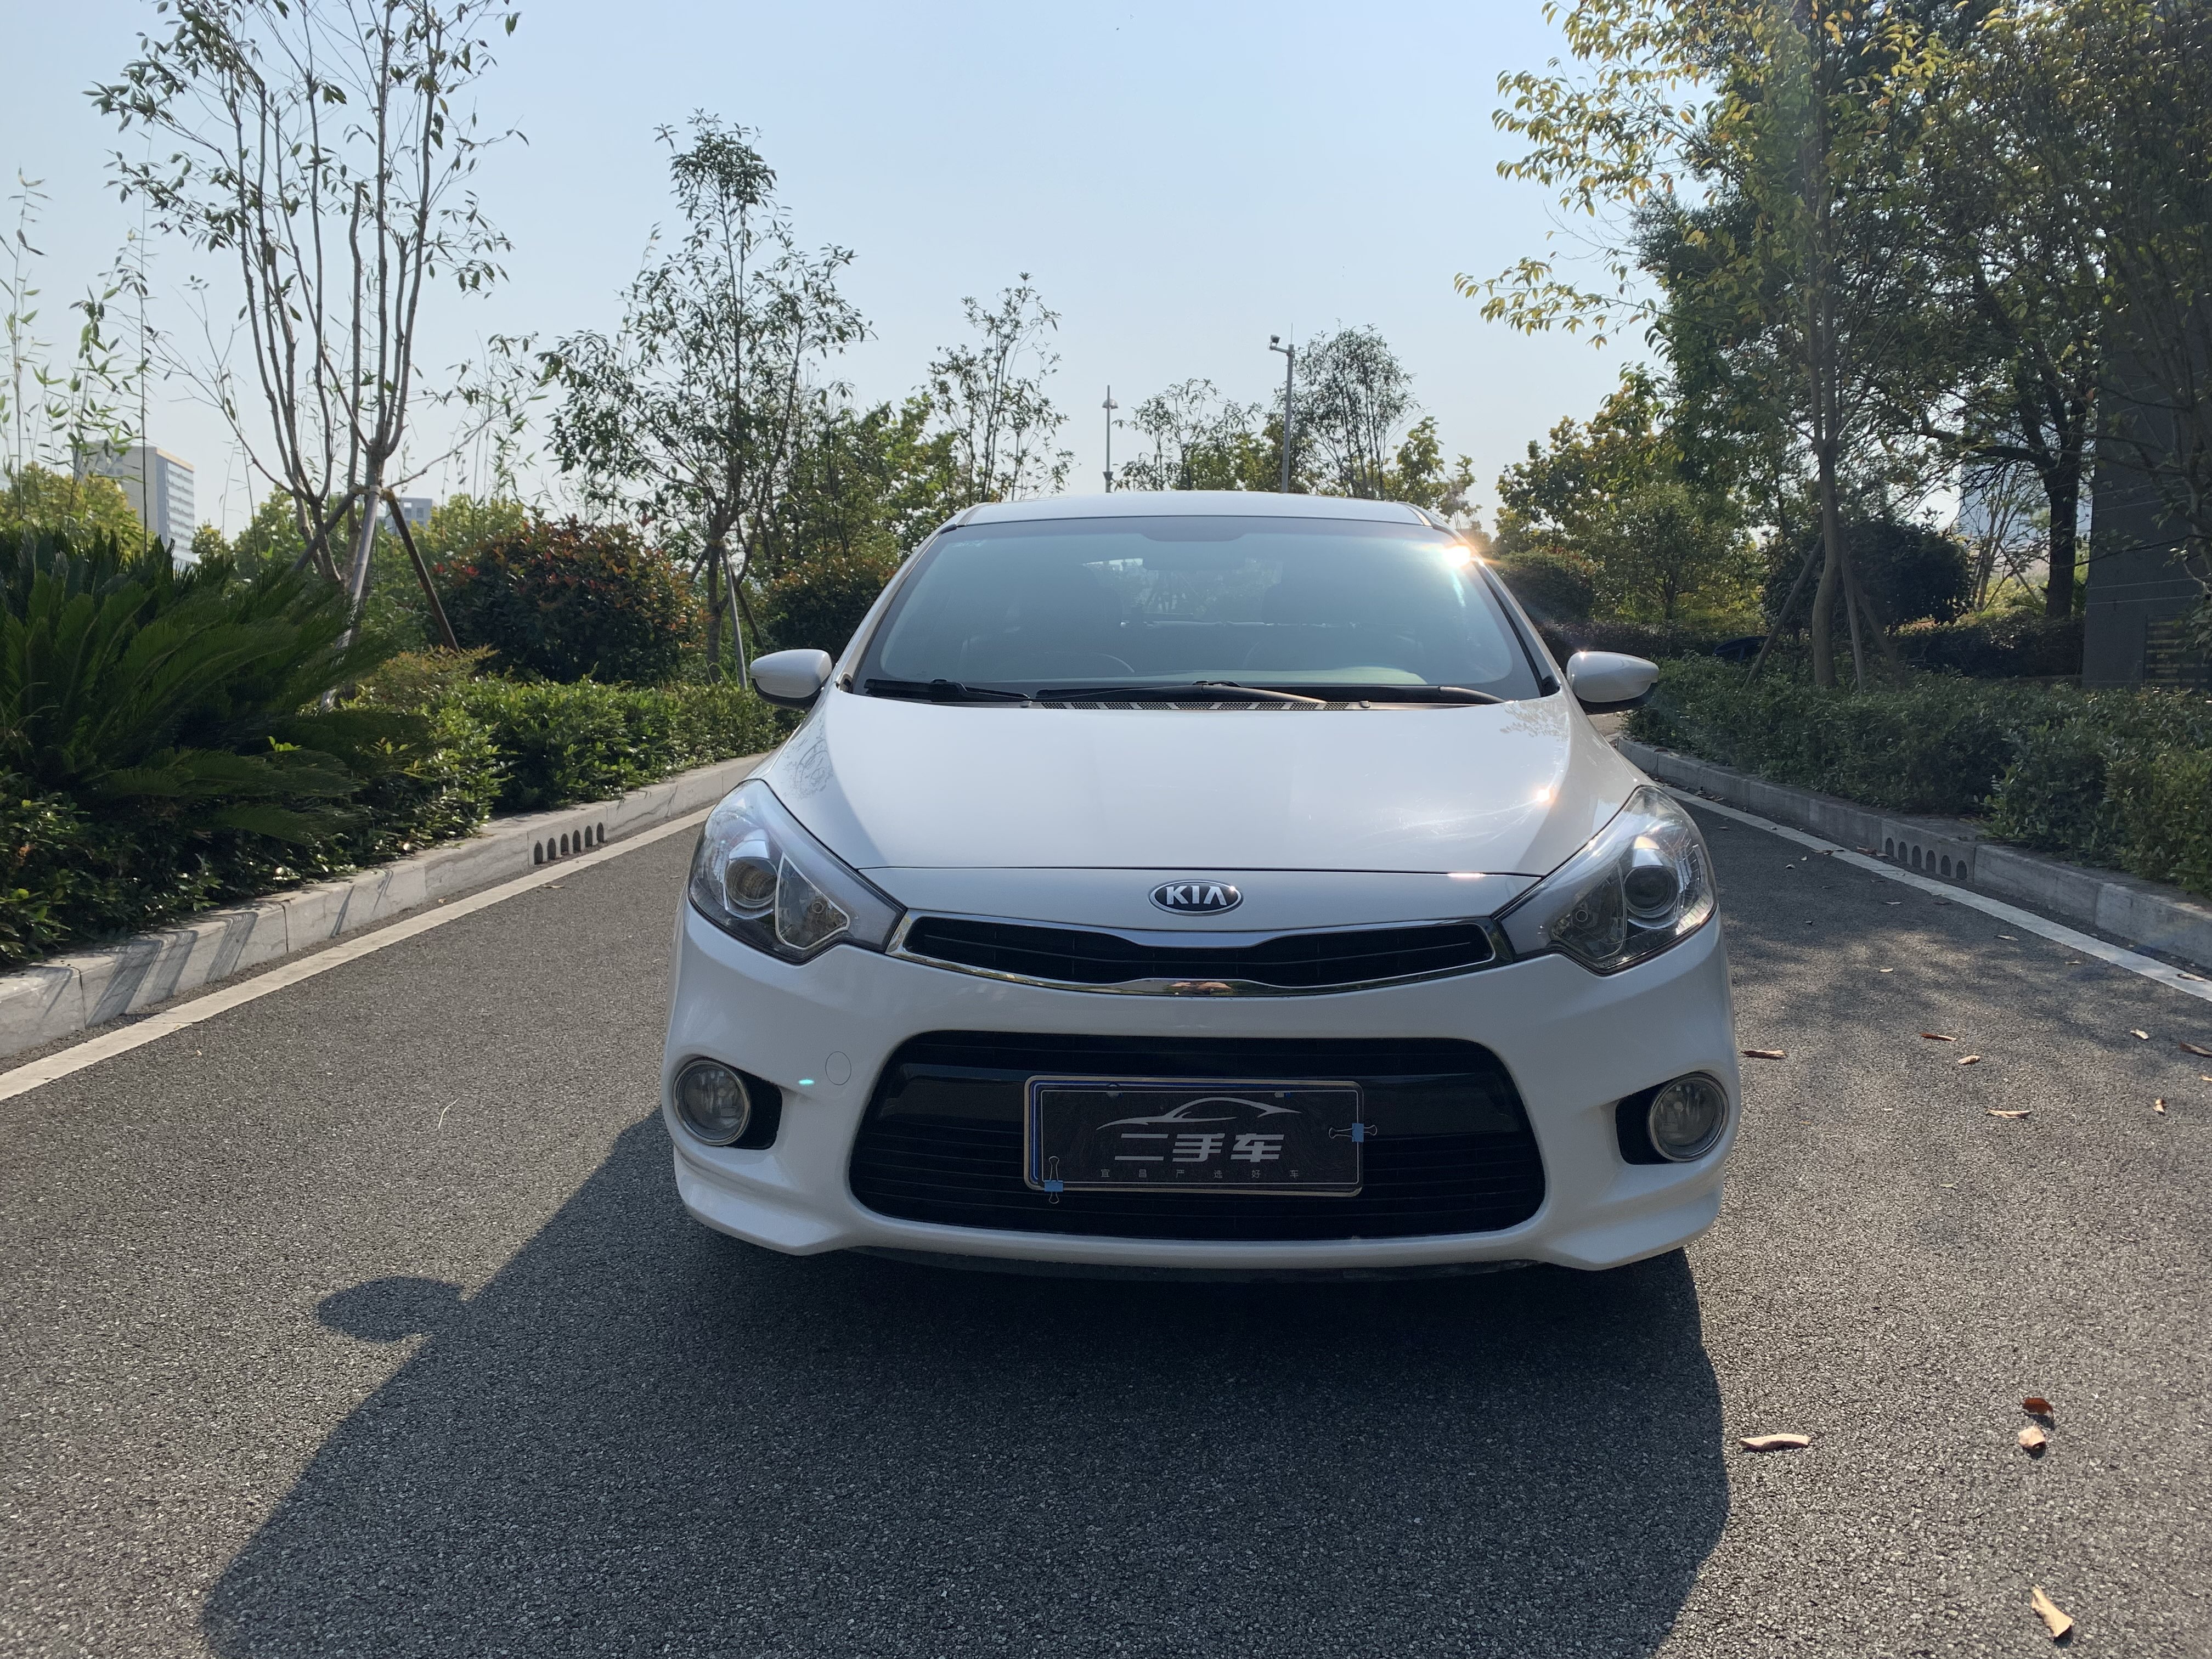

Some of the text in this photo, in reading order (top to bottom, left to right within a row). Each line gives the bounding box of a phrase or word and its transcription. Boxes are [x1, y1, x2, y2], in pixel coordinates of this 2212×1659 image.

[1165, 885, 1227, 905] KIA
[1115, 1133, 1284, 1163] 二手车
[1101, 1169, 1299, 1178] 宜昌严选好车
